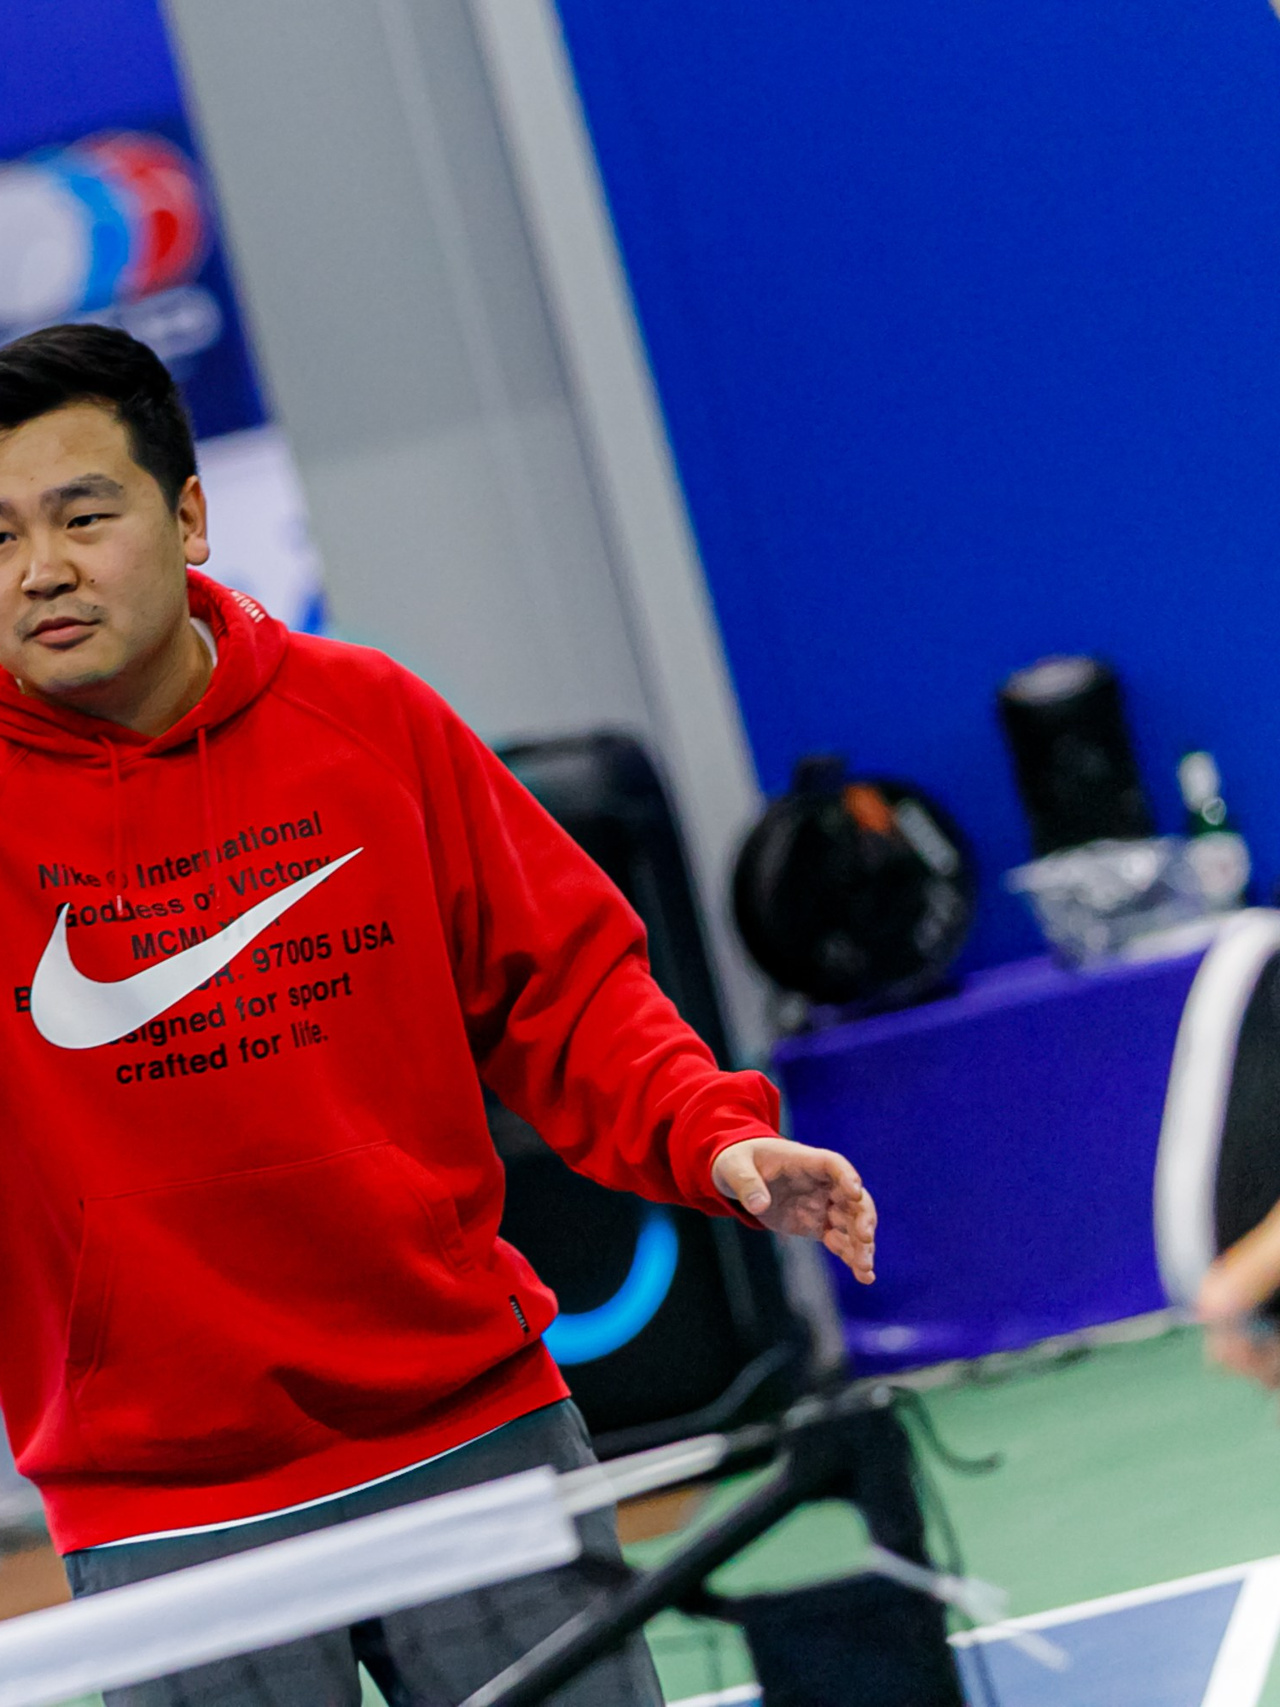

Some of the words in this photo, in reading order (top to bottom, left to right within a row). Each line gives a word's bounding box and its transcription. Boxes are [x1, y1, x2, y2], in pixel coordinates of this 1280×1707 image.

[38, 863, 102, 889] Nike
[136, 811, 322, 888] International
[56, 898, 185, 928] Goddess
[251, 933, 332, 973] 97005
[342, 920, 395, 954] USA
[108, 1002, 226, 1046] signed
[234, 991, 277, 1021] for
[288, 971, 353, 1010] sport
[116, 1043, 228, 1084] crafted
[238, 1034, 282, 1063] for
[290, 1019, 328, 1048] life.
